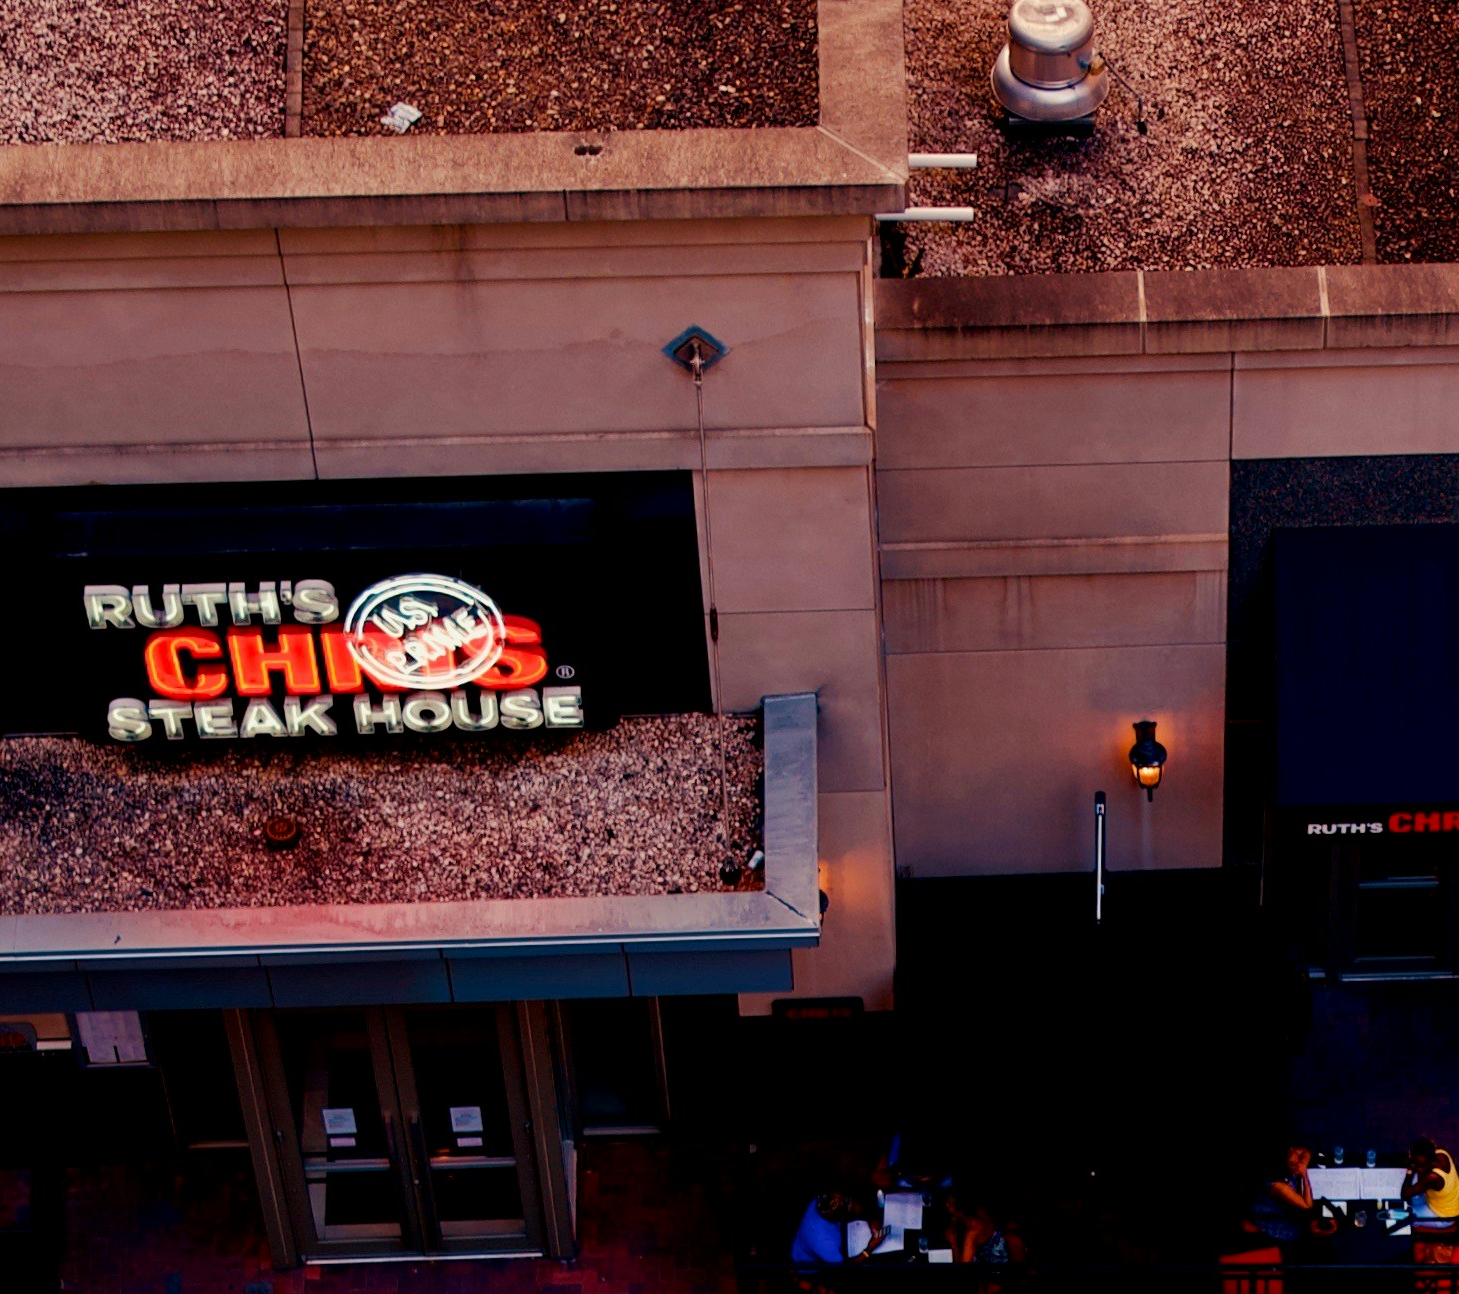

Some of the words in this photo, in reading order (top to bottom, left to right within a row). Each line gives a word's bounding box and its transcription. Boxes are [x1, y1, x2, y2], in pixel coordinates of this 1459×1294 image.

[84, 579, 338, 628] RUTH'S
[108, 695, 338, 740] STEAK
[354, 686, 583, 732] HOUSE
[1307, 822, 1383, 835] RUTH'S
